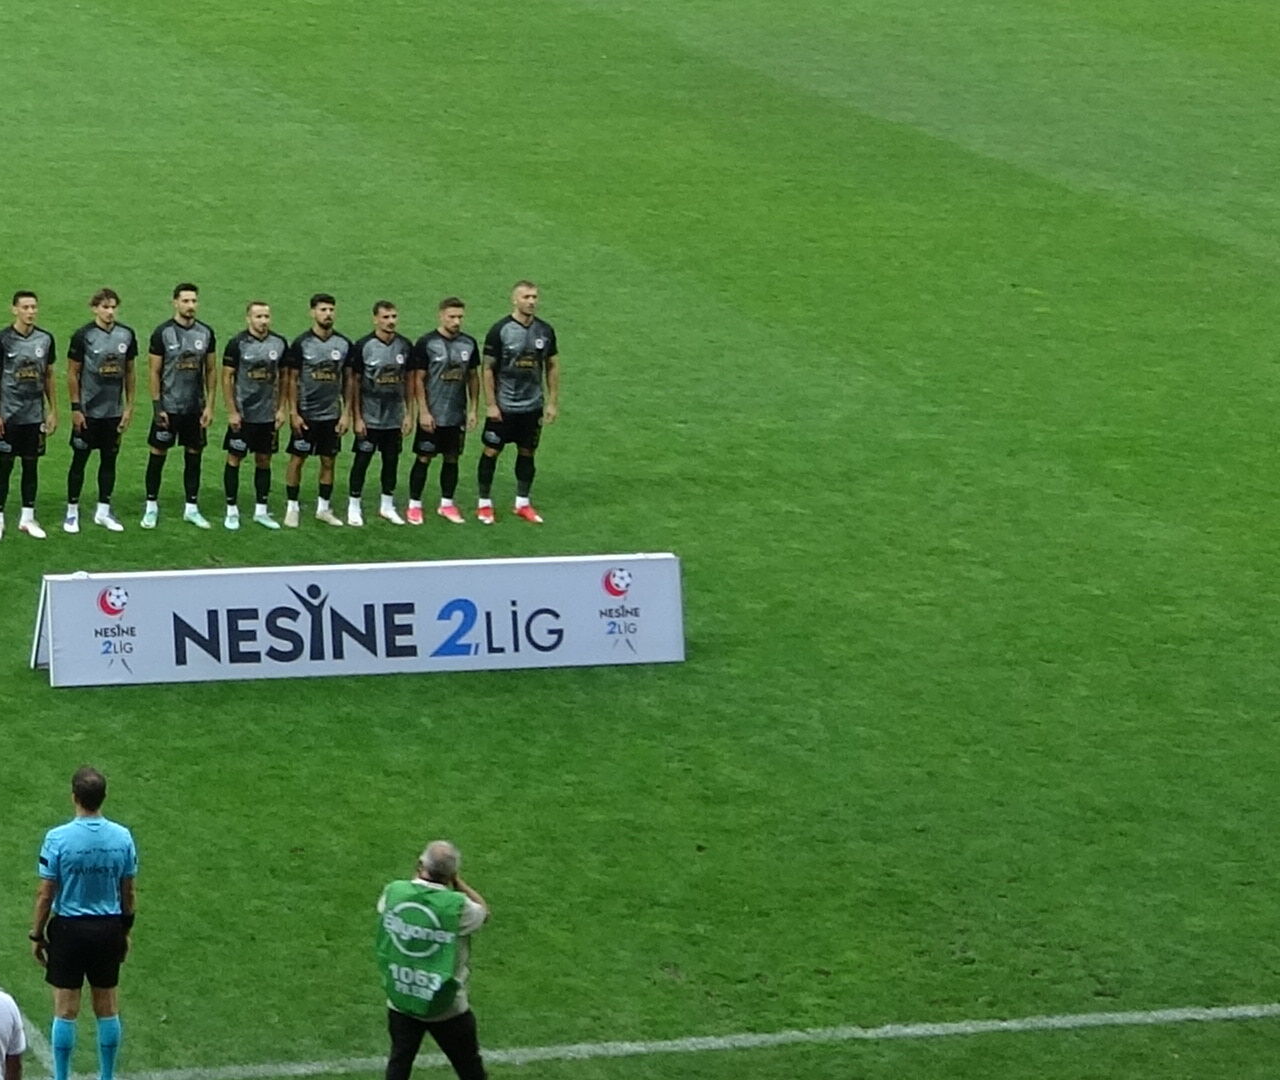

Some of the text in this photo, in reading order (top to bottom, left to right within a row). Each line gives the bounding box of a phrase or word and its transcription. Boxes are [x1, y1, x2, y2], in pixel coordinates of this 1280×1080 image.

[599, 604, 640, 619] NESİNE
[94, 624, 137, 638] NESİNE
[172, 583, 418, 666] NESİNE
[388, 963, 442, 992] 1063
